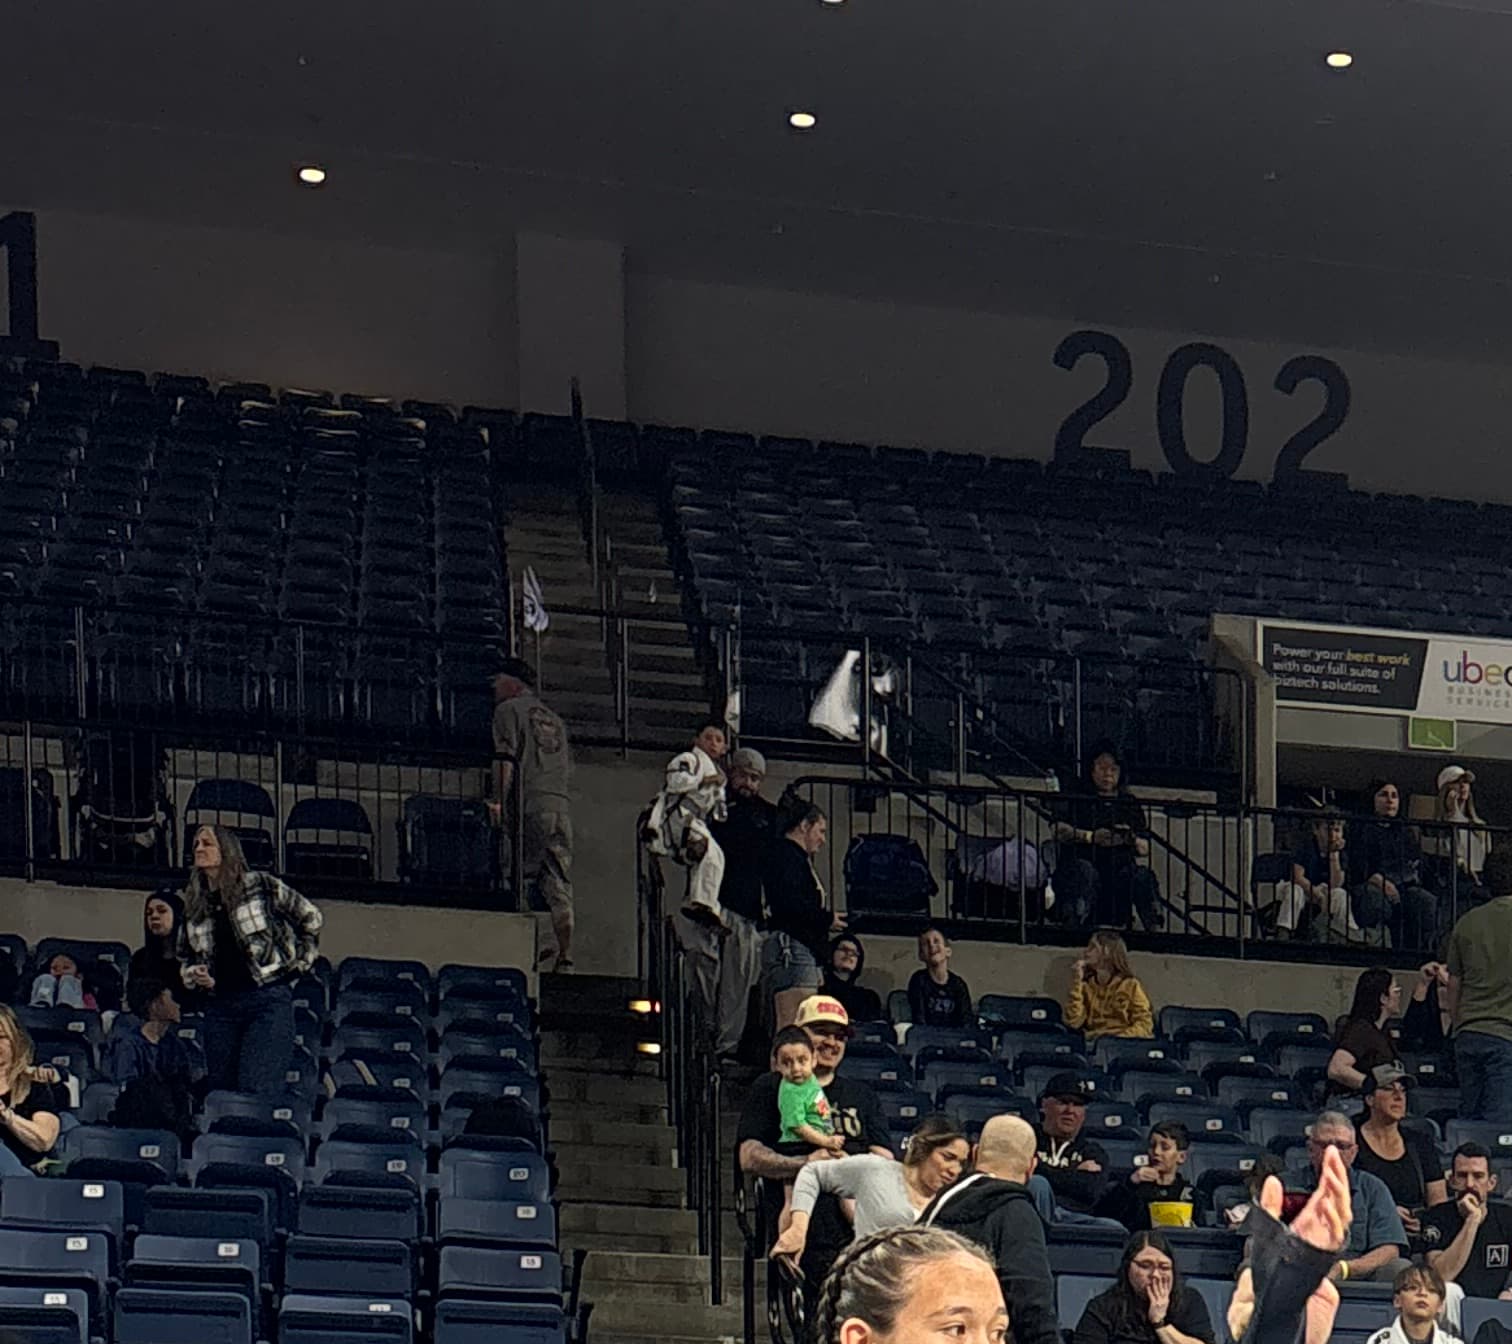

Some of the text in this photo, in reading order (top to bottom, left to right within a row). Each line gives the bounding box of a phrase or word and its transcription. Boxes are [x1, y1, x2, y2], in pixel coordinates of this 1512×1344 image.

[1053, 330, 1351, 494] 202
[1272, 643, 1410, 666] Power your best work
[1272, 660, 1397, 681] with our full suite of
